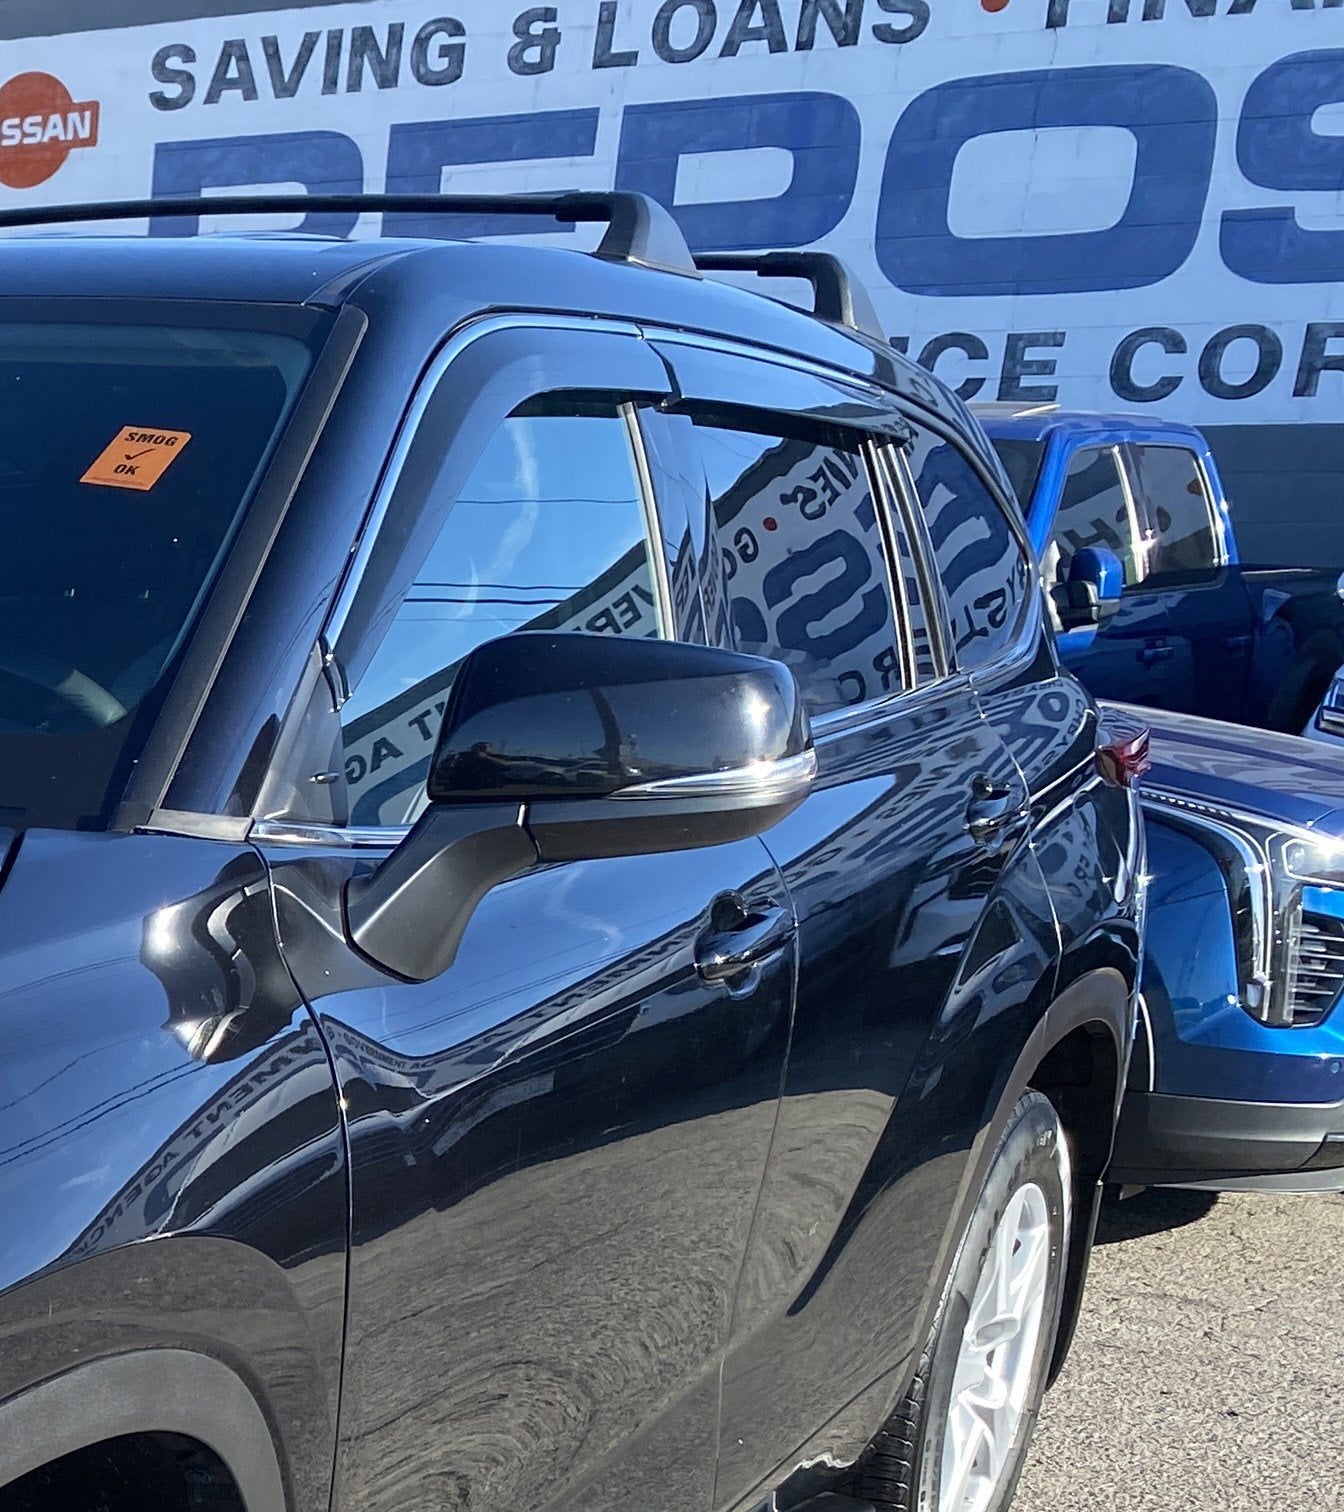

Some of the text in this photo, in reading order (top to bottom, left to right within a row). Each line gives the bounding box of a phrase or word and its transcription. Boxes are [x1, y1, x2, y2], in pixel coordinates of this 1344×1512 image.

[148, 0, 932, 112] SAVING & LOANS
[124, 432, 179, 447] SMOG
[113, 463, 140, 475] OK
